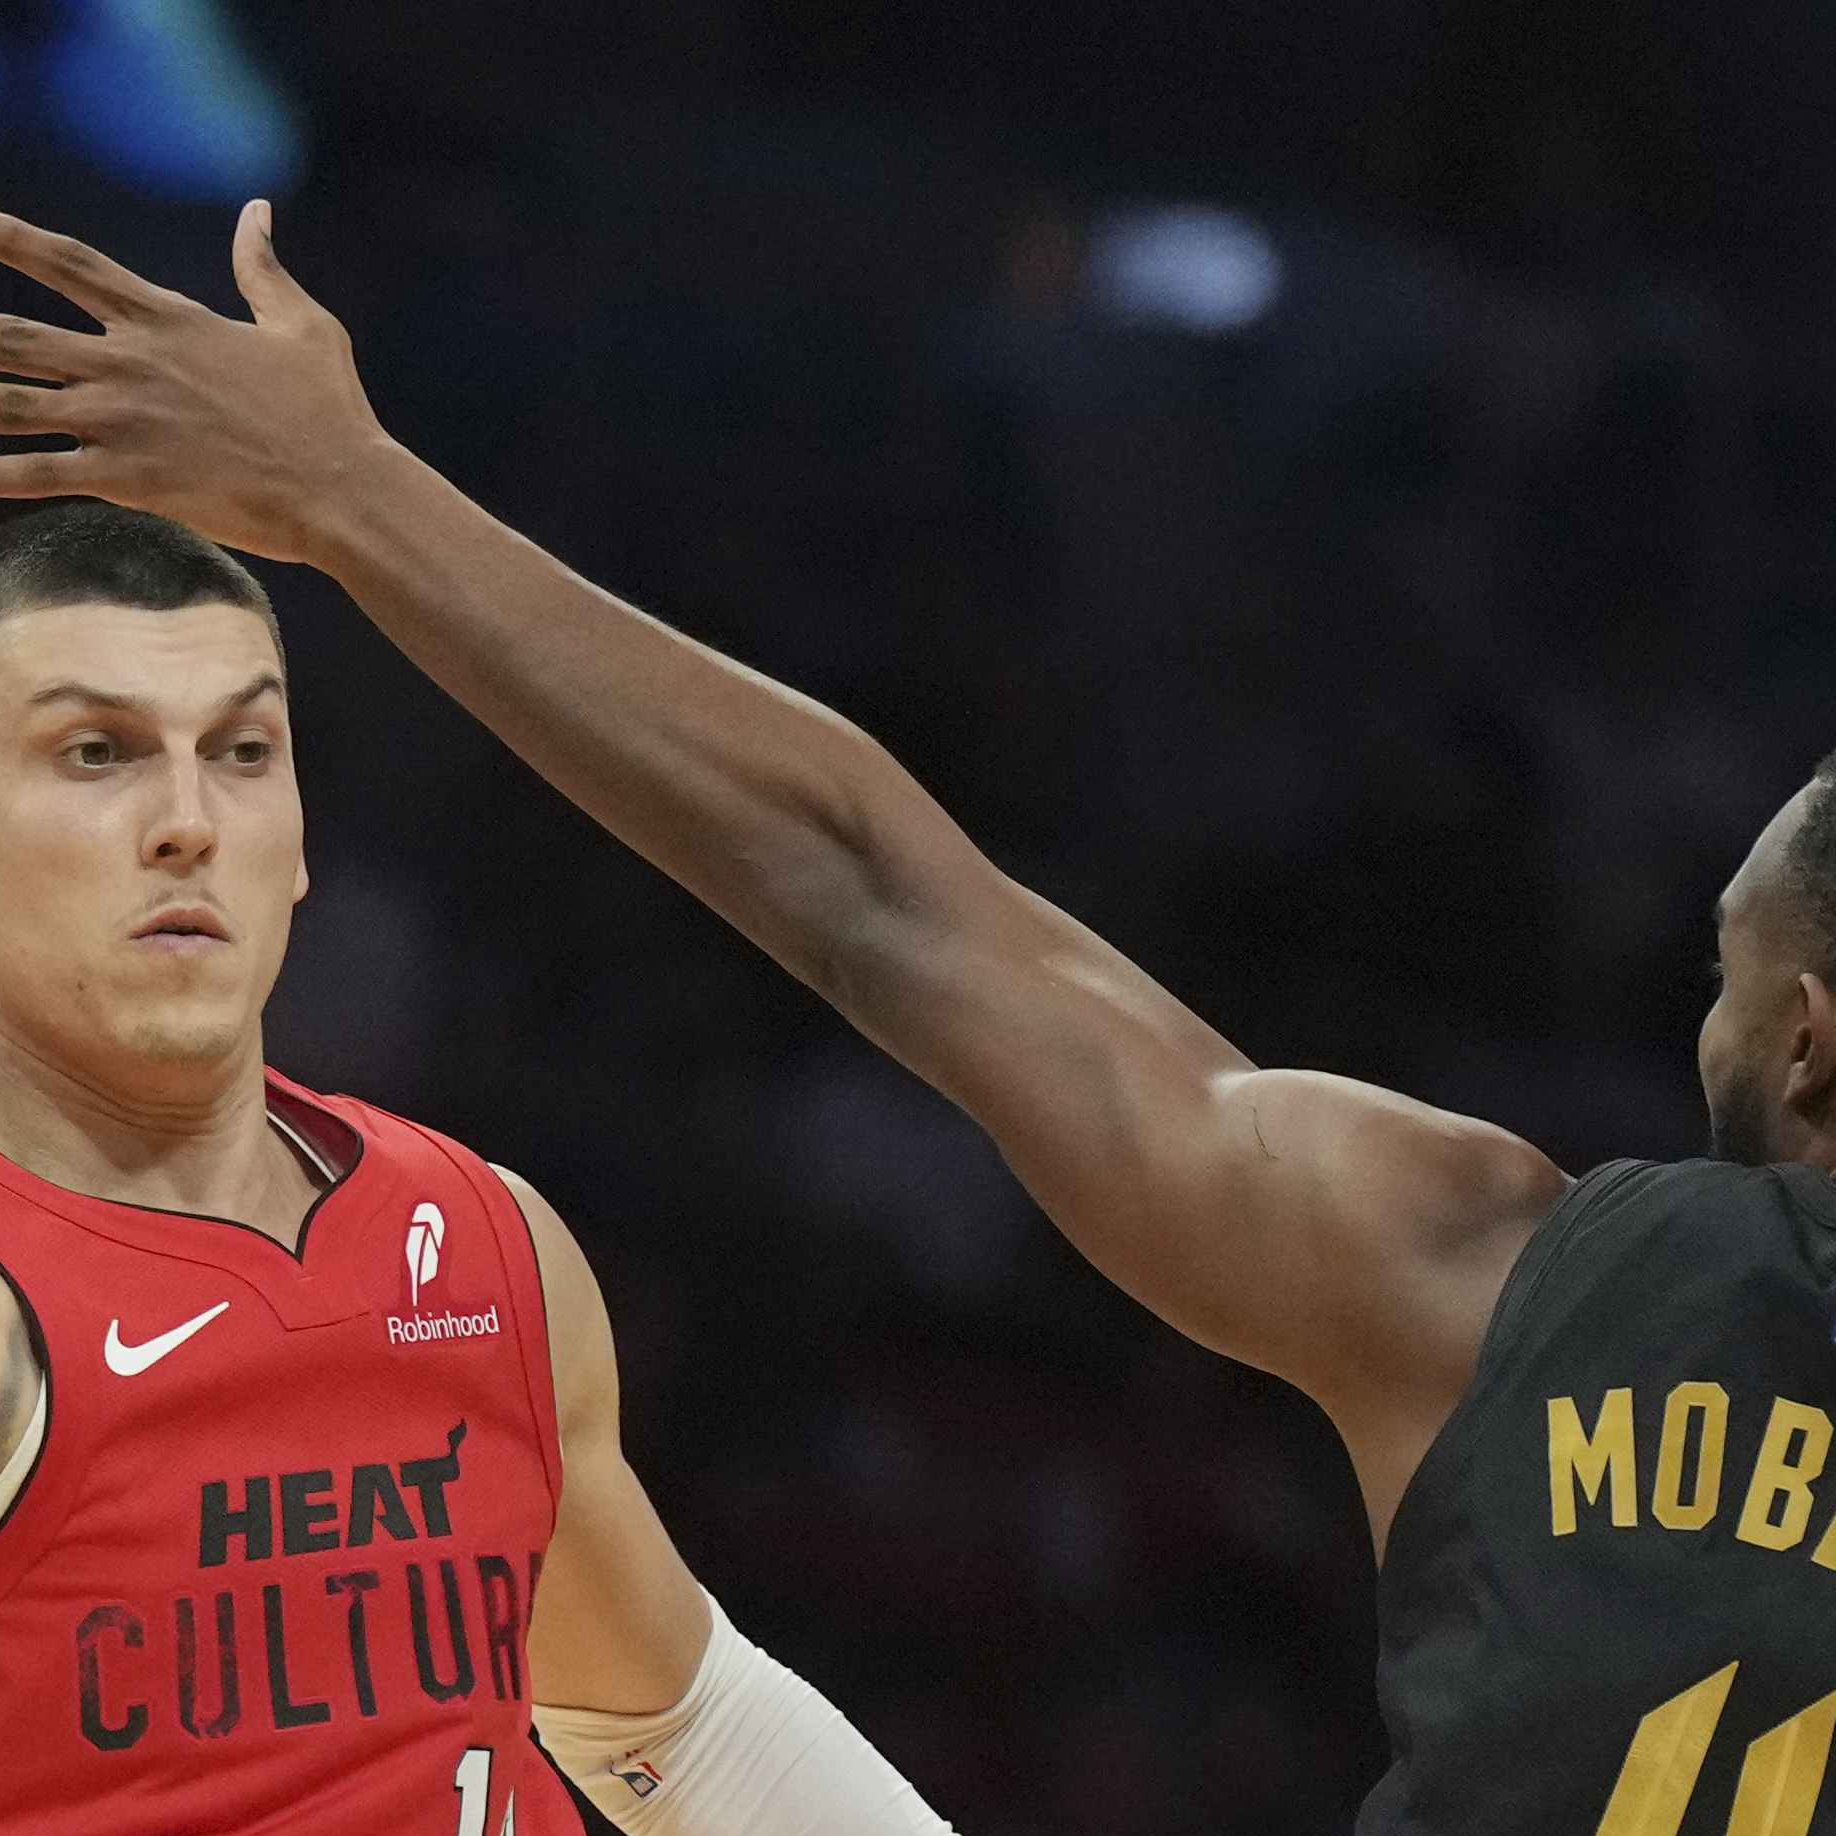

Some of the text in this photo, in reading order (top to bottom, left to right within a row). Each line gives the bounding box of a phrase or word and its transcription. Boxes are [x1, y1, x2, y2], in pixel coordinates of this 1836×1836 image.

[387, 1306, 500, 1345] Robinhood
[198, 1419, 466, 1568] HEAT
[75, 1551, 545, 1752] CULTUR
